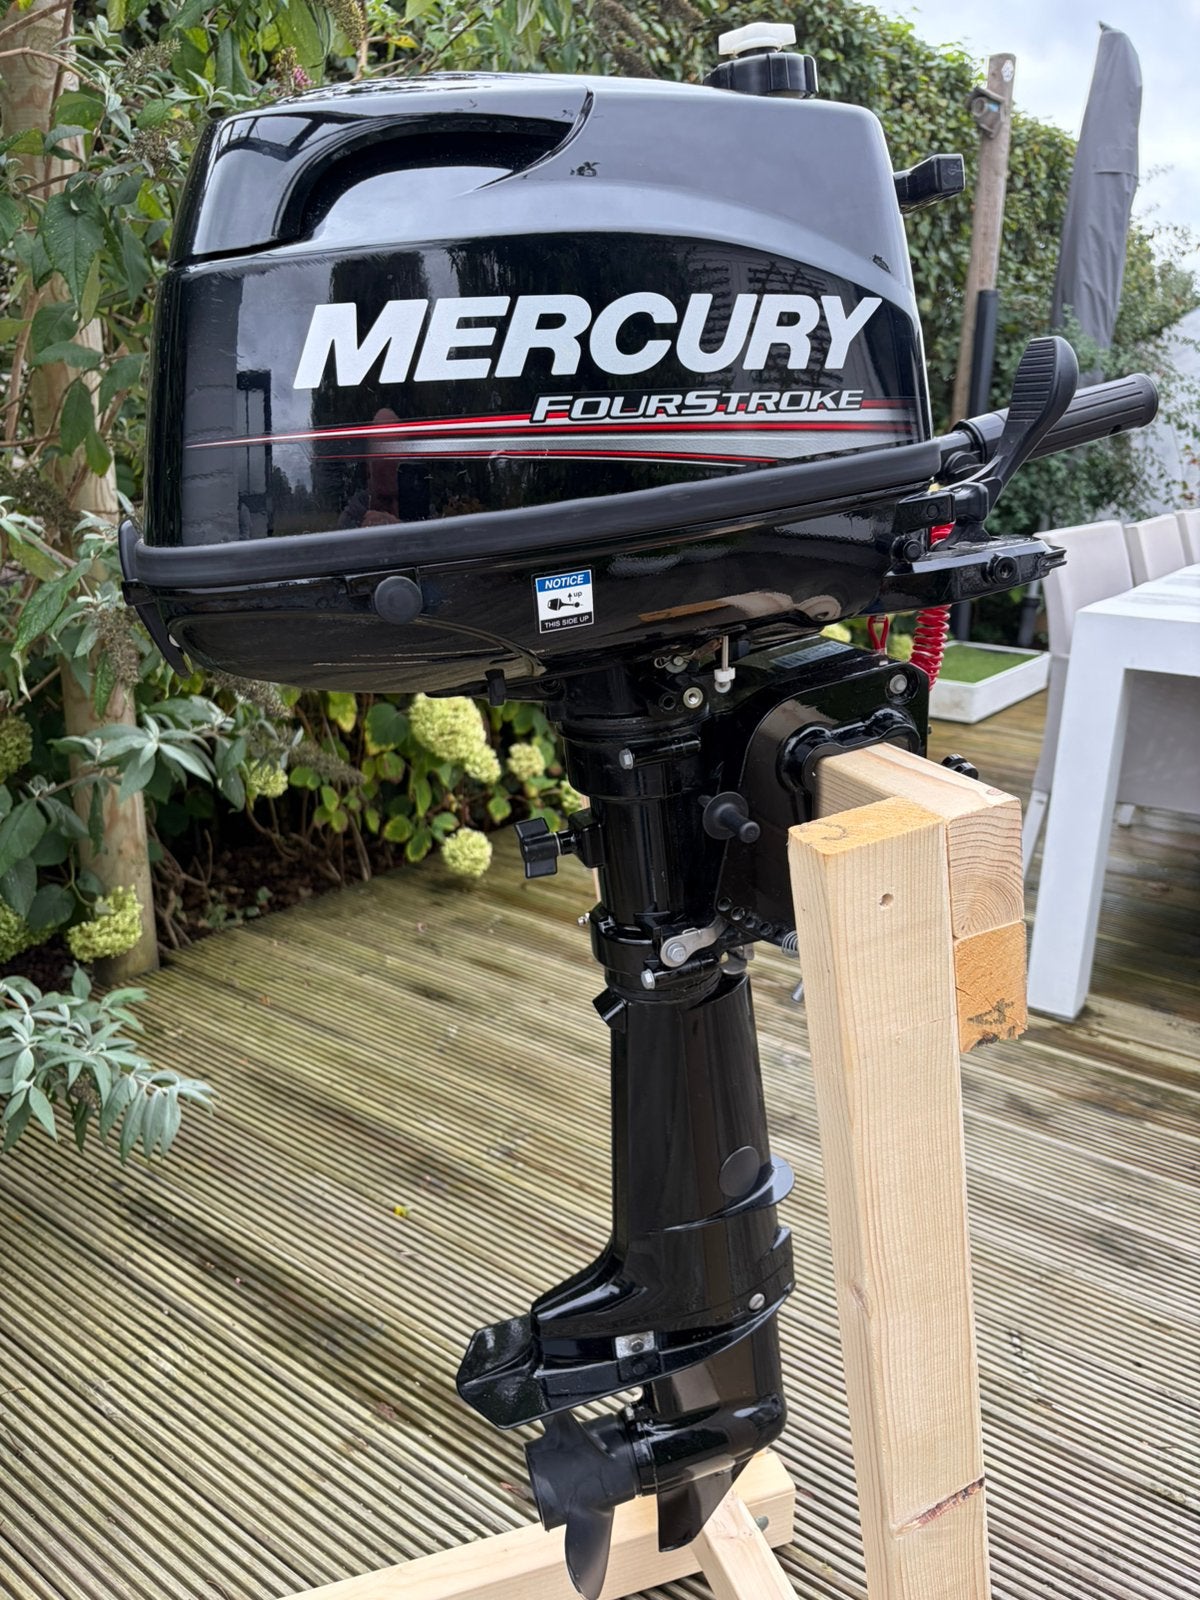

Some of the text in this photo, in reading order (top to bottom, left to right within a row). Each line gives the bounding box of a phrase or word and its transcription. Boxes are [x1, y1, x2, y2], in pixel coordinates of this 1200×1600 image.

[293, 291, 882, 389] MERCURY
[545, 574, 585, 589] NOTICE
[545, 620, 561, 629] THIS
[562, 617, 578, 626] SIDE
